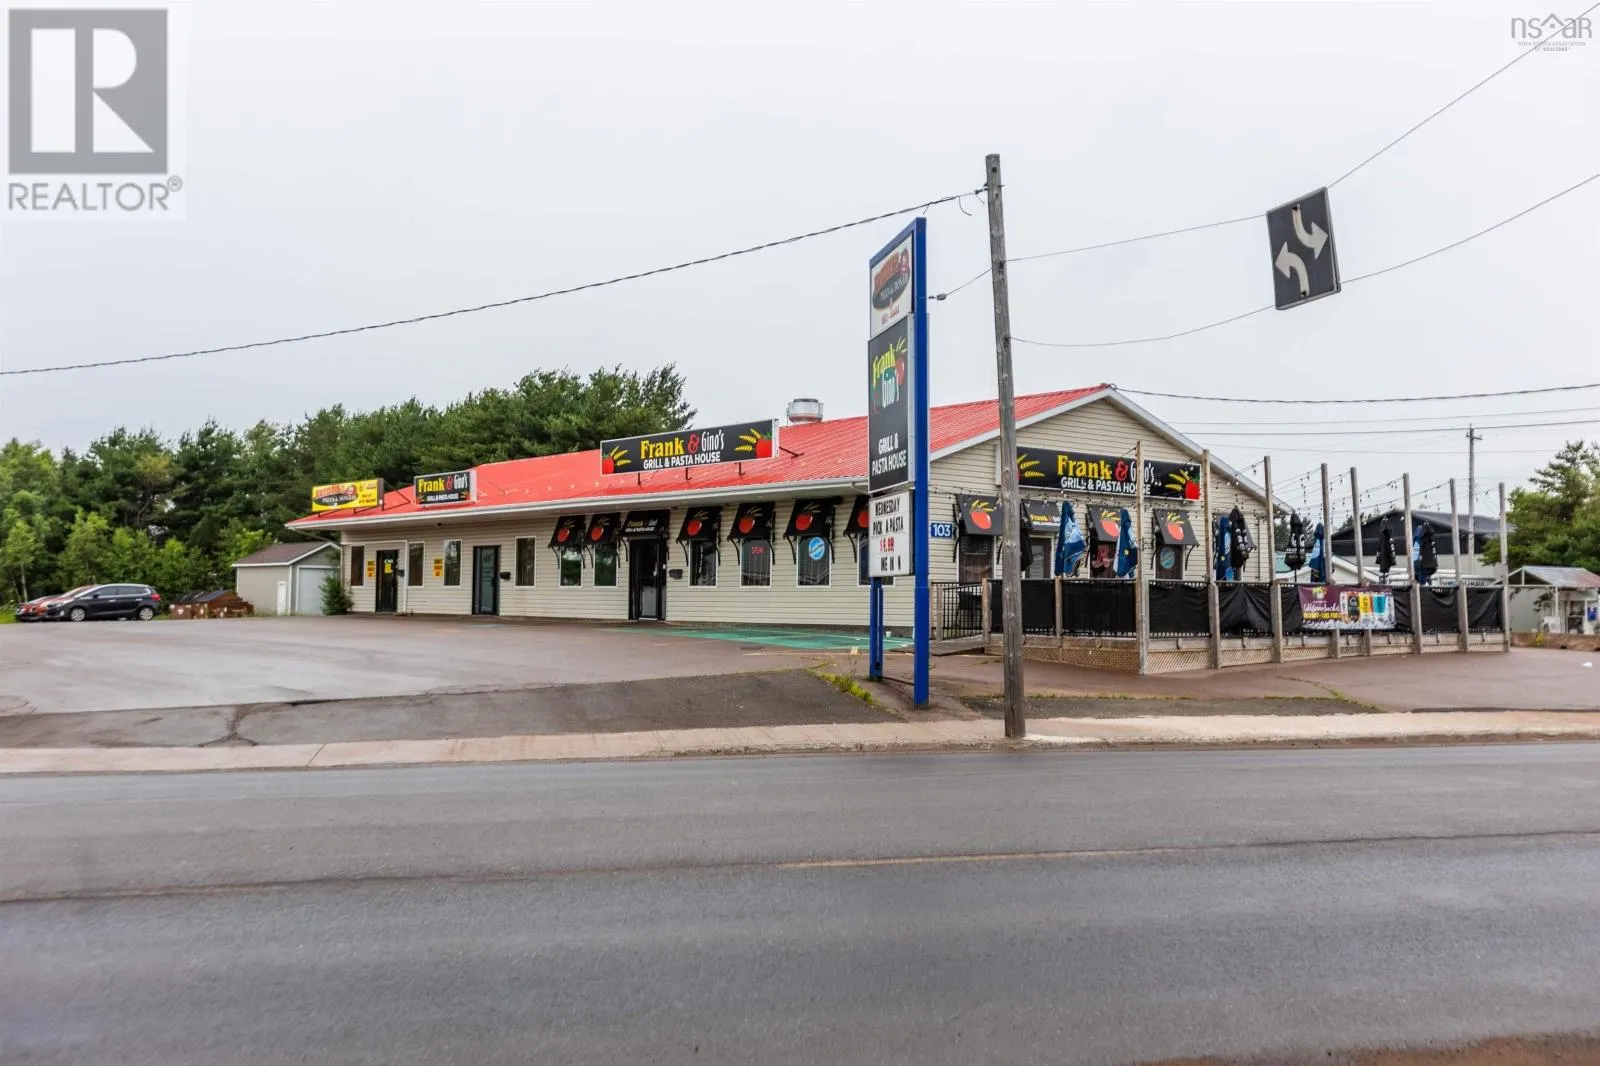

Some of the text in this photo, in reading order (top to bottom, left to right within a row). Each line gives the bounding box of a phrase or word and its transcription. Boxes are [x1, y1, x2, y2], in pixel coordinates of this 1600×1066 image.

[640, 428, 725, 459] Frank & Gino's
[878, 435, 893, 455] GRILL
[643, 451, 721, 470] GRILL & PASTA HOUSE
[872, 449, 907, 476] PASTA HOUSE
[1056, 454, 1156, 484] Frank & Go's
[418, 477, 445, 493] Frank
[1088, 479, 1094, 489] &
[1095, 479, 1122, 492] PASTA
[1123, 482, 1151, 495] HOE
[875, 496, 901, 516] WEDNESDAY
[872, 516, 904, 536] PICK A PASTA
[932, 524, 951, 537] 103
